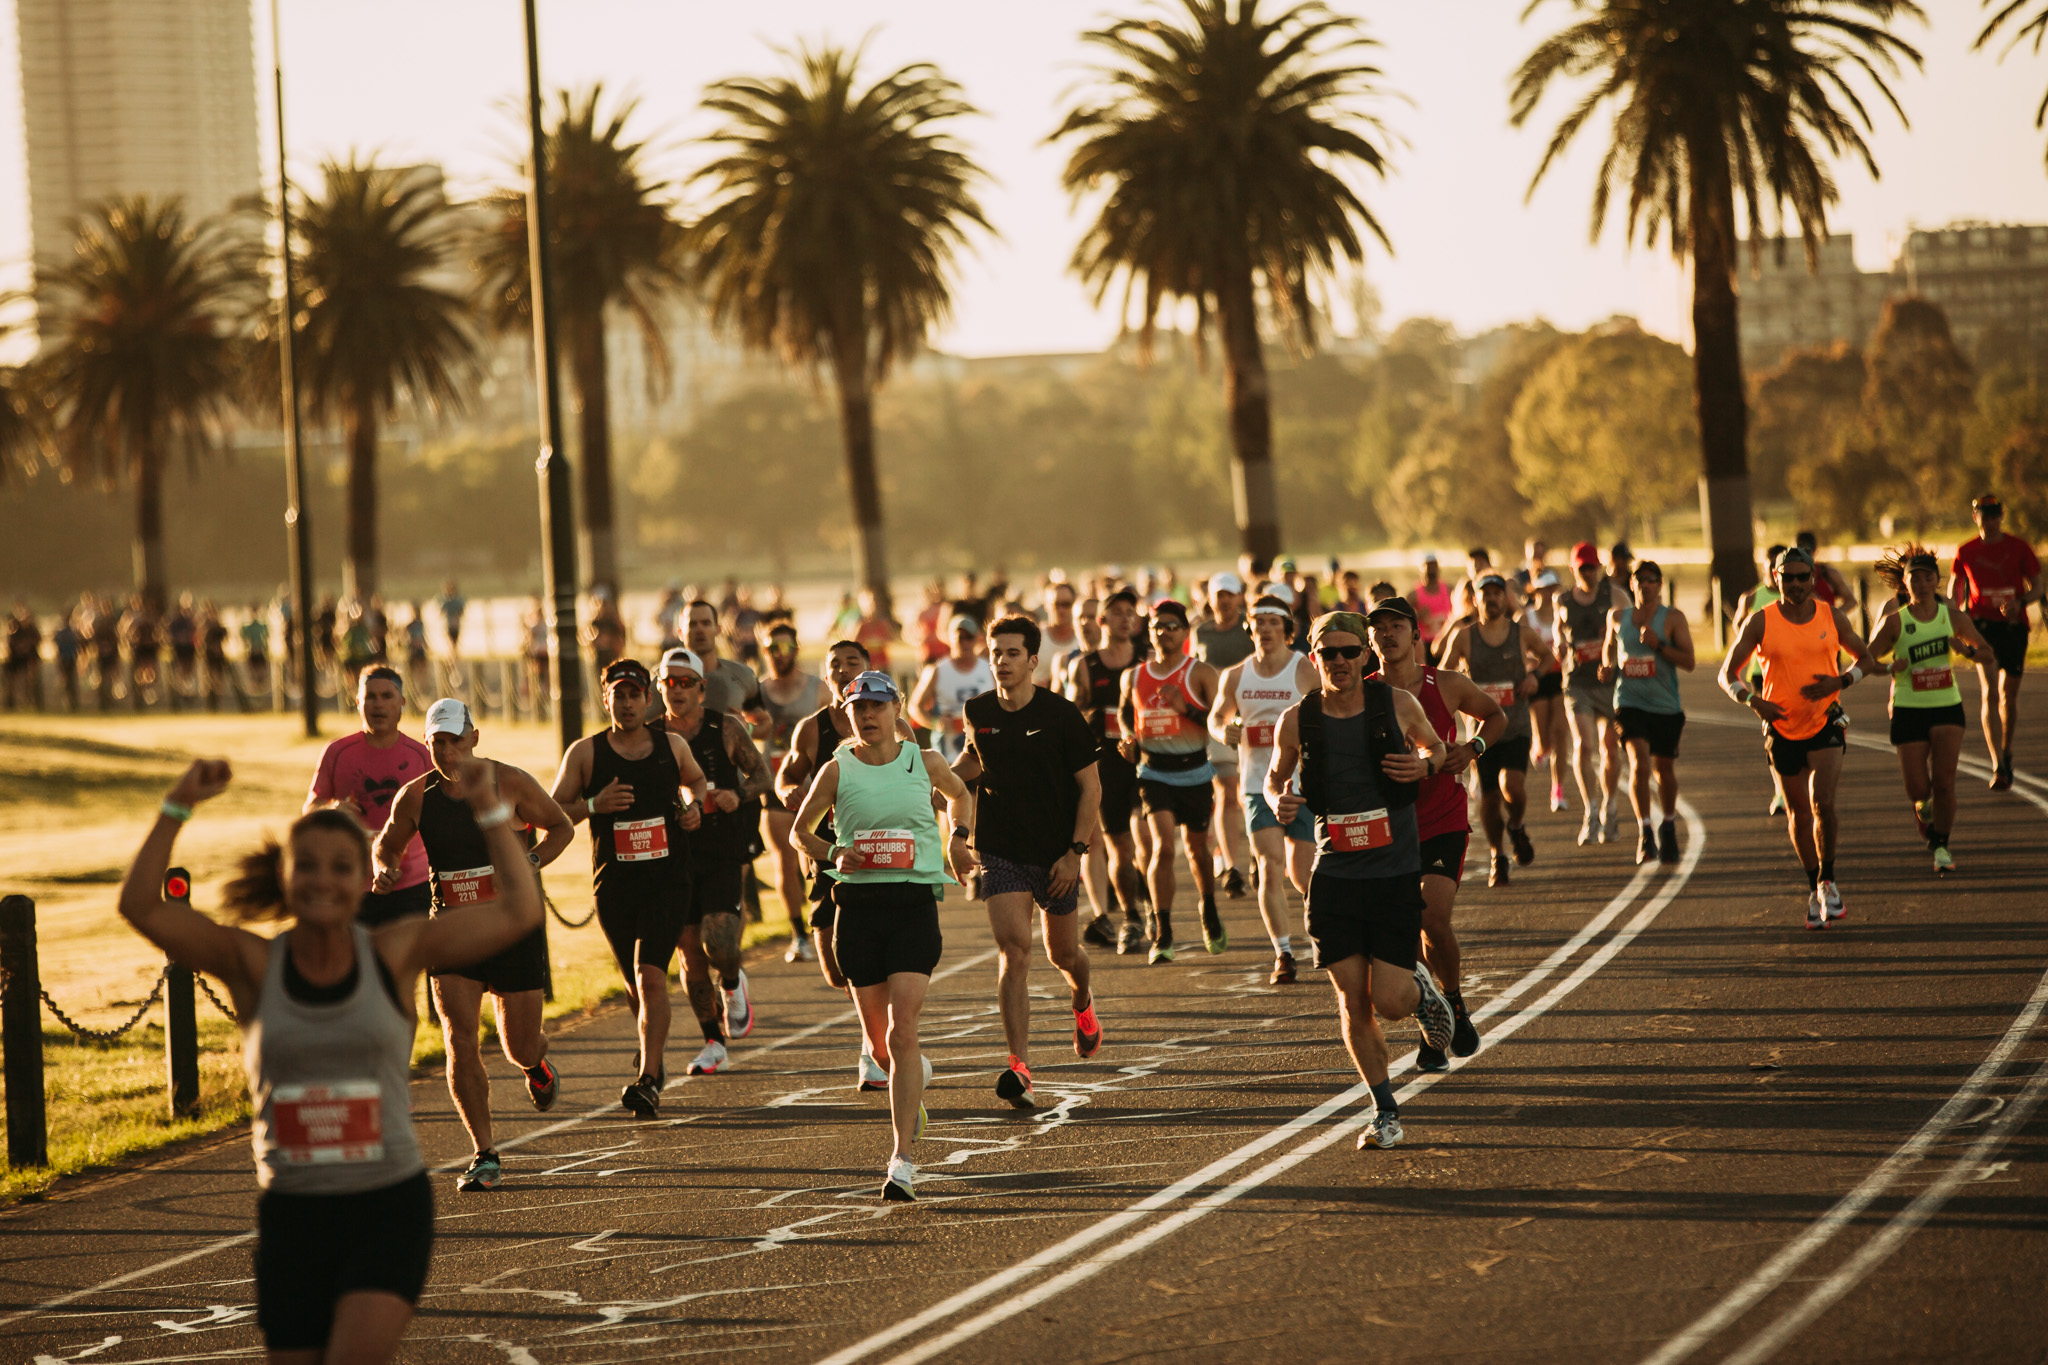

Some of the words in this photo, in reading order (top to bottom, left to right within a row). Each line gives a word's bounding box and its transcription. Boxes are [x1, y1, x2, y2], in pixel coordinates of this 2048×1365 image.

[1914, 641, 1944, 660] HNTR
[1242, 690, 1292, 700] CLOGGERS
[629, 830, 652, 841] AARON
[1345, 825, 1369, 837] JIMMY
[632, 840, 651, 850] 5272
[1350, 836, 1370, 847] 1952
[860, 843, 875, 853] MRS
[875, 842, 907, 853] CHUBBS
[872, 853, 892, 864] 4685
[452, 881, 479, 892] BROADY
[459, 891, 478, 902] 2219
